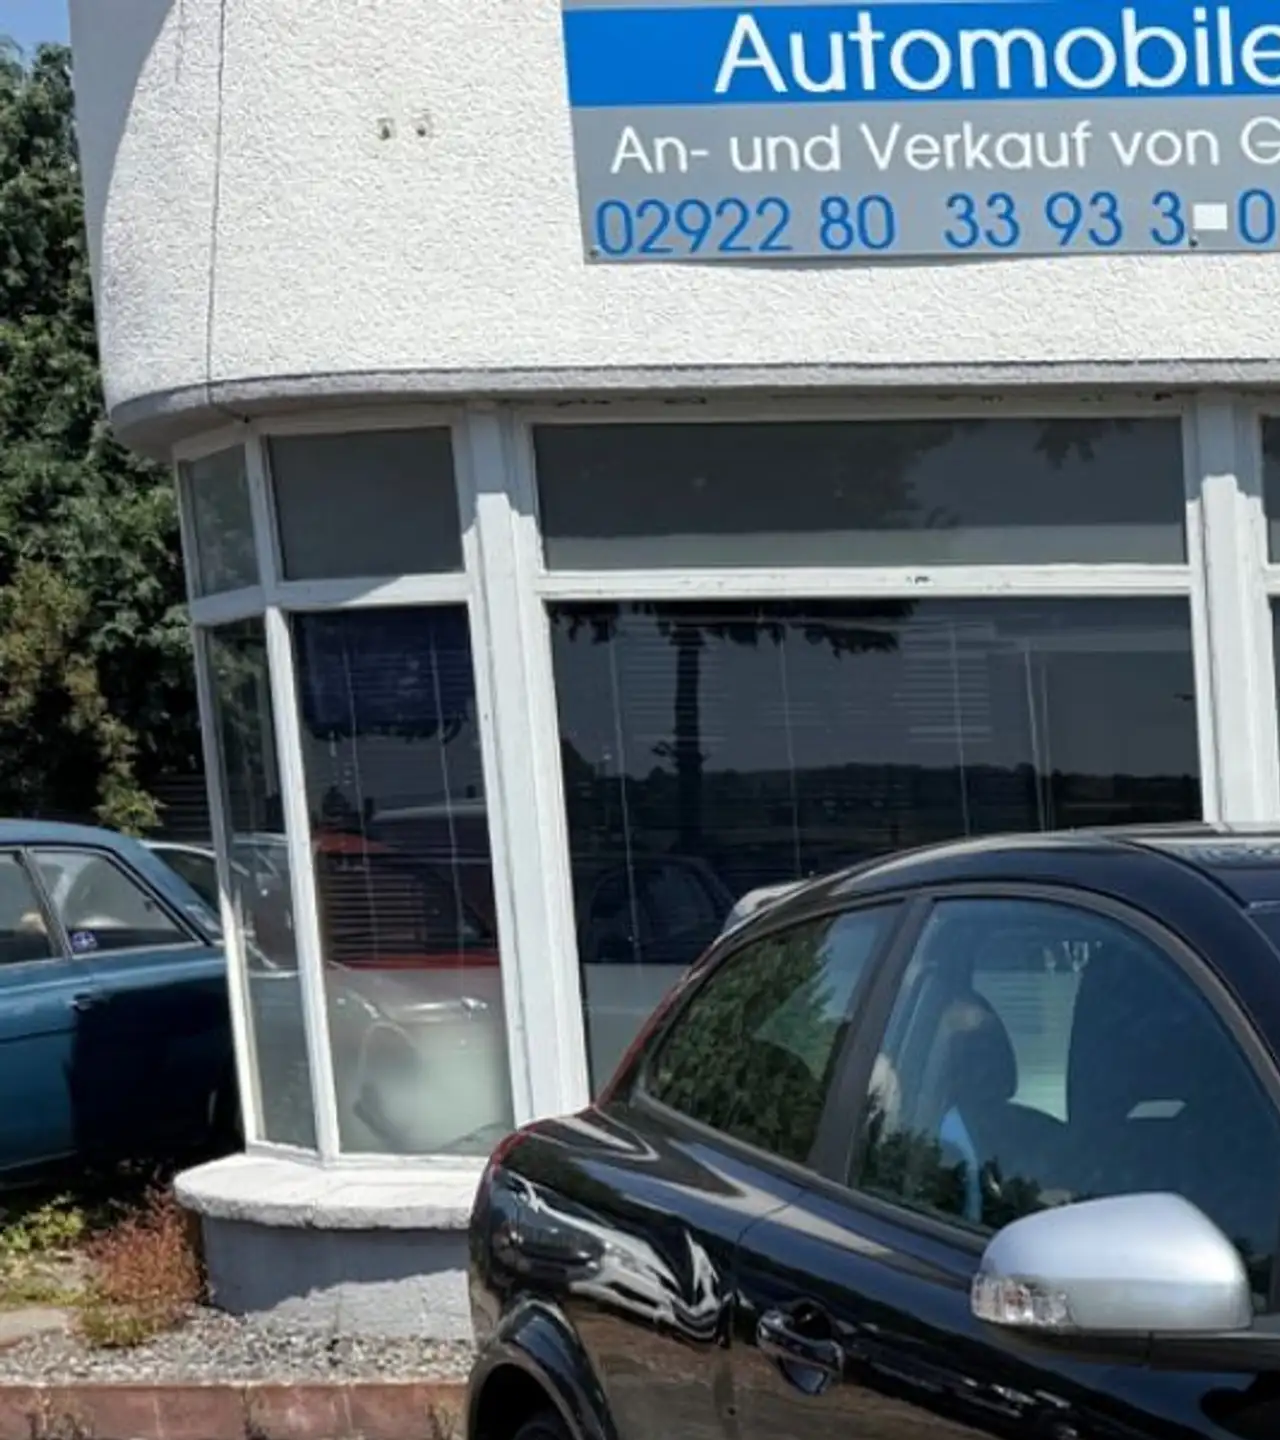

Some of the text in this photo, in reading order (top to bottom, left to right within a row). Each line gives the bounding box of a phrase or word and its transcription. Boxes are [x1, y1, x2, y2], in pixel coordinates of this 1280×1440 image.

[610, 125, 709, 174] An-
[729, 124, 841, 172] und
[860, 119, 1092, 171] Verkauf
[1108, 129, 1220, 167] von
[595, 197, 792, 256] 02922
[819, 193, 897, 251] 80
[944, 191, 1021, 249] 33
[1044, 190, 1124, 247] 93
[1150, 190, 1187, 247] 3
